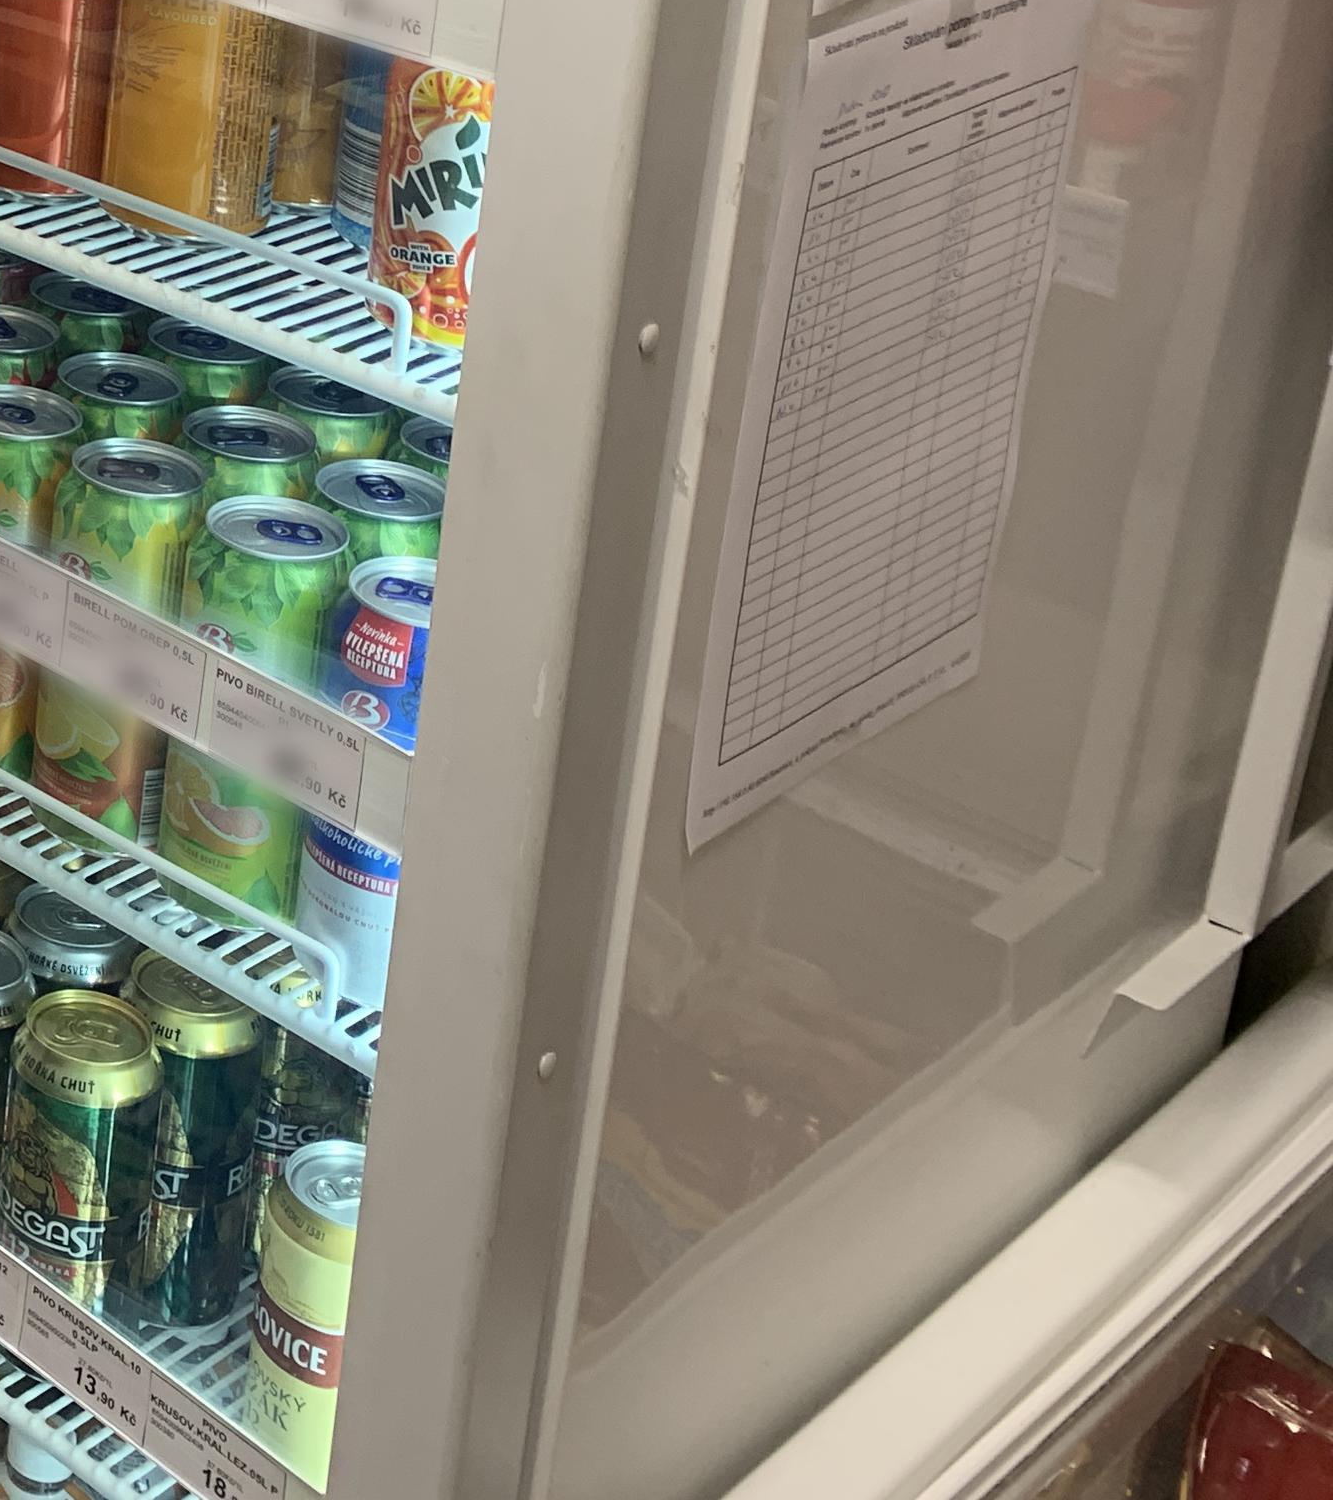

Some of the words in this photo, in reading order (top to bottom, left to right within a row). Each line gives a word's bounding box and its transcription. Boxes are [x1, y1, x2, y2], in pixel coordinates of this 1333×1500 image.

[142, 6, 218, 27] FLAVOURED
[399, 18, 422, 37] Kč
[390, 247, 456, 268] ORANGE
[72, 591, 111, 619] BIRELL
[172, 641, 195, 666] 0,5L
[345, 631, 405, 670] VYLEPŠENÁ
[345, 649, 396, 680] RECEPTURA
[170, 704, 189, 724] Kč
[216, 667, 244, 692] PIVO
[245, 680, 286, 712] BIRELL
[288, 702, 335, 737] SVETLY
[335, 727, 360, 753] 0,5L
[327, 788, 348, 810] Kč
[59, 1075, 97, 1096] CHUŤ
[32, 1285, 57, 1309] PIVO
[73, 1364, 116, 1411] 13,90
[119, 1405, 138, 1428] Kč
[201, 1418, 229, 1444] PIVO
